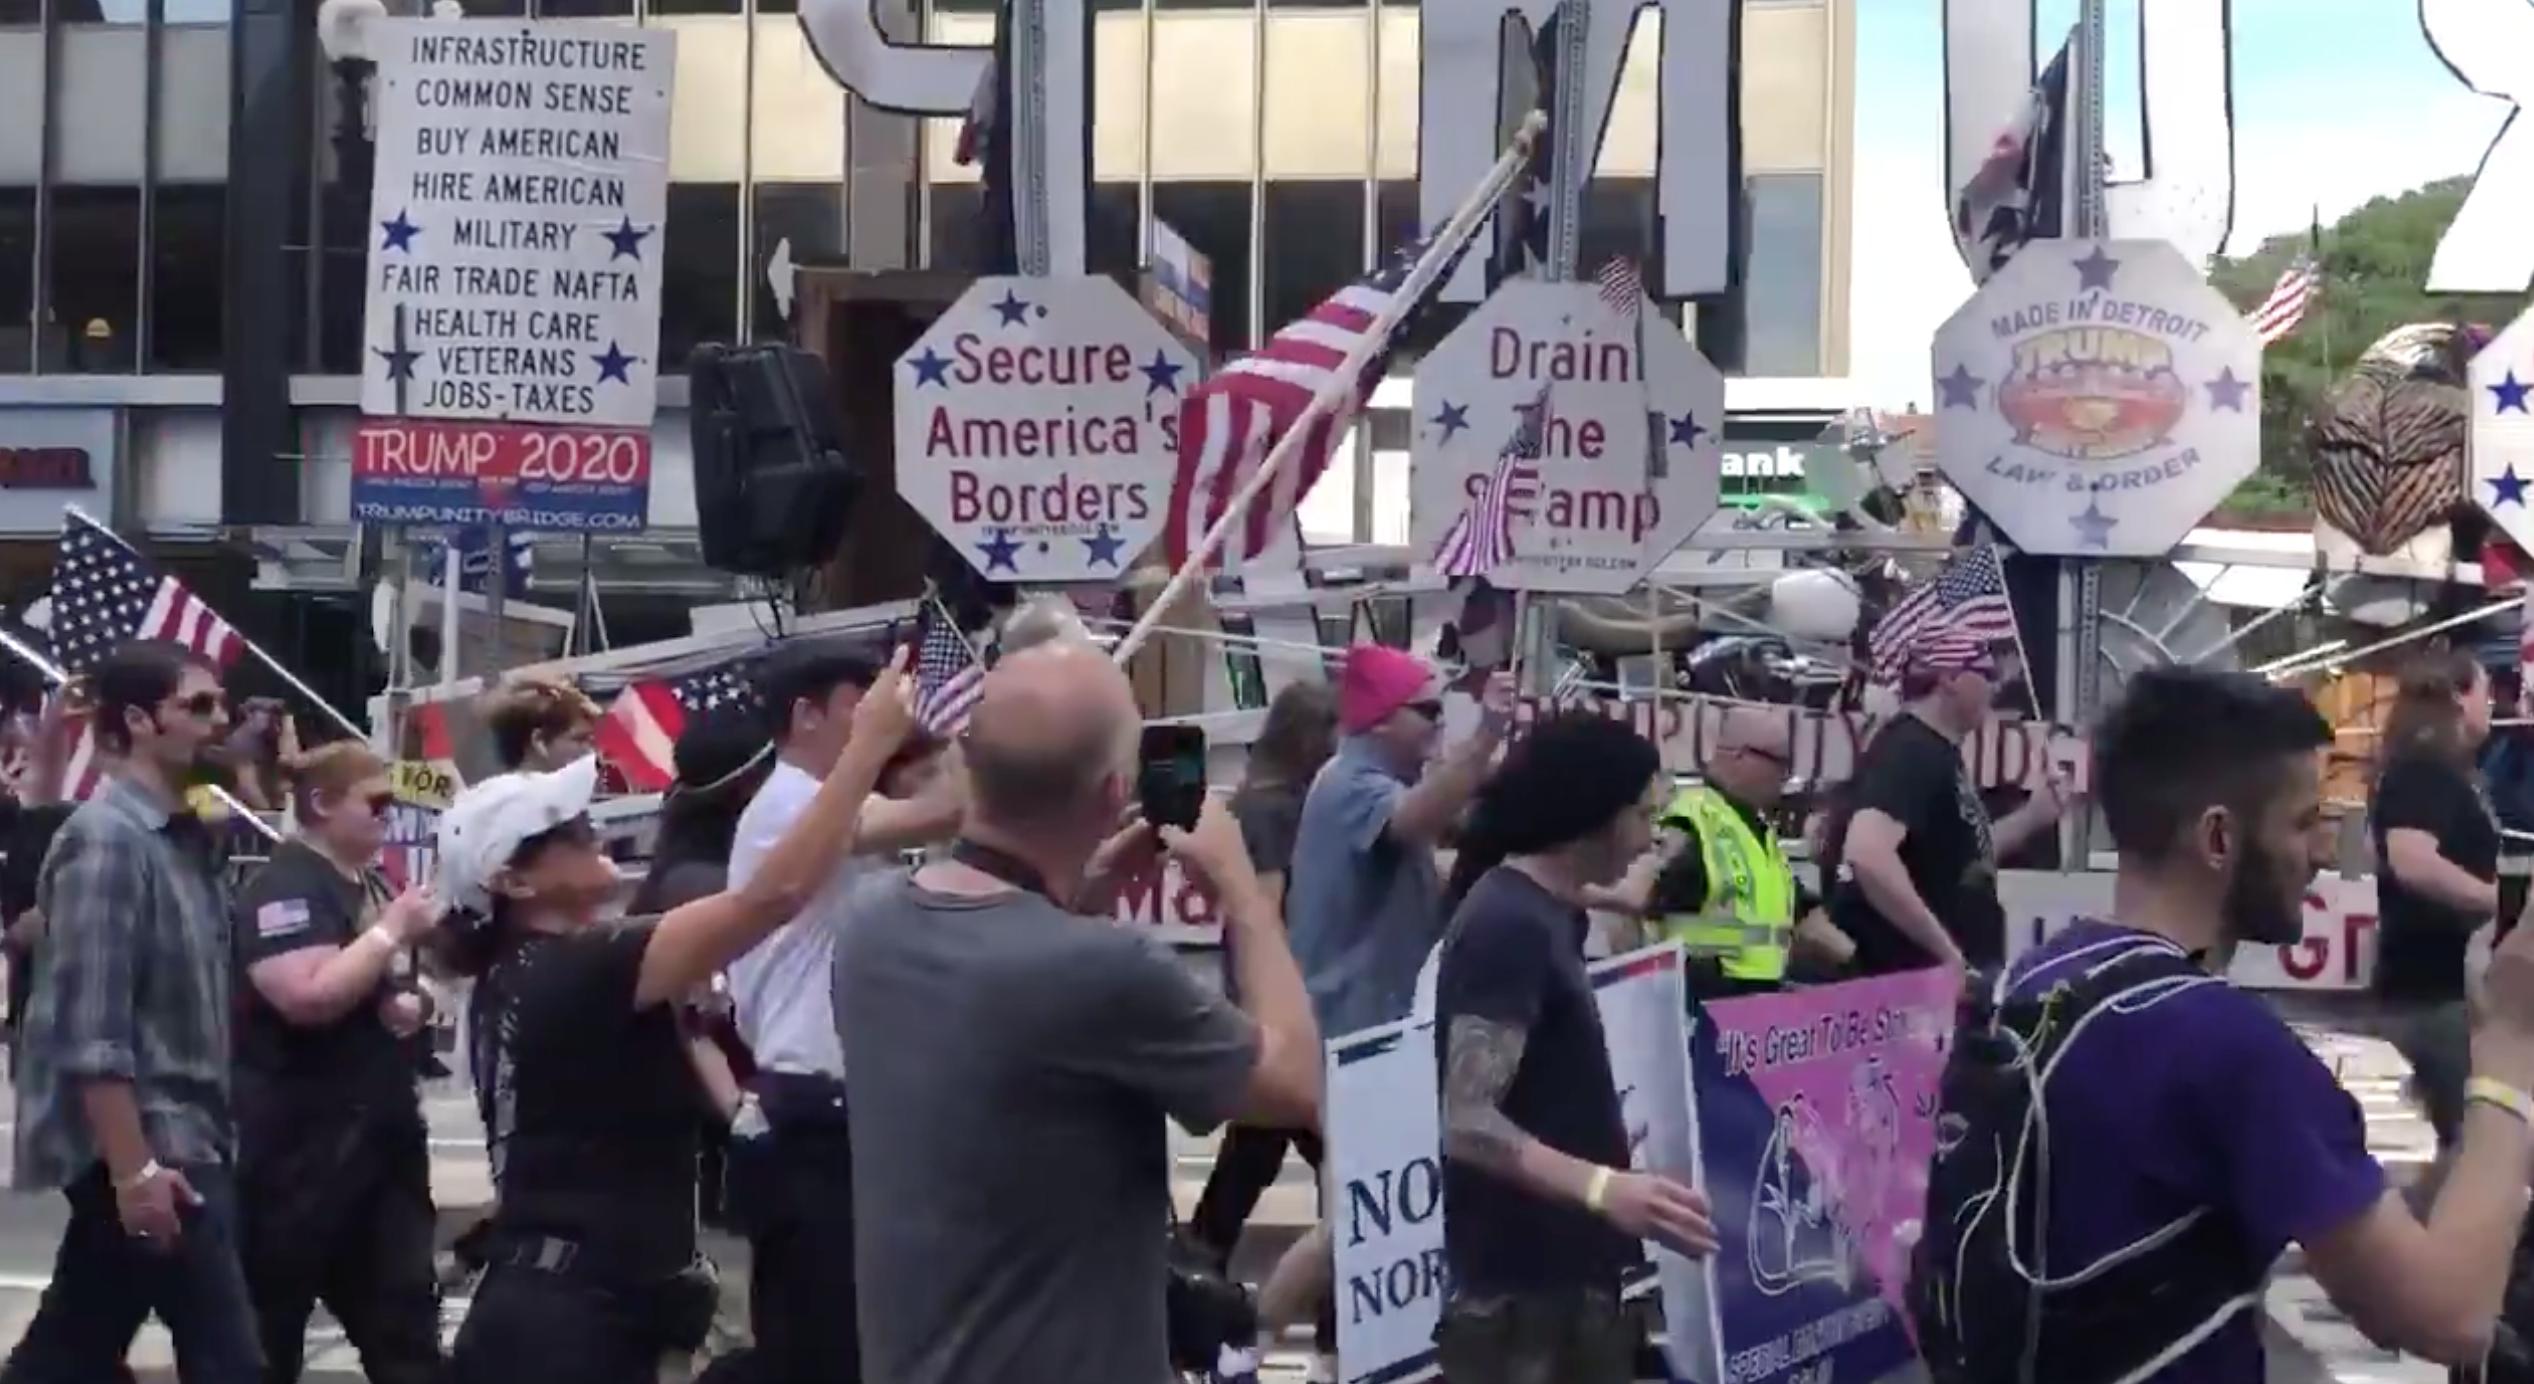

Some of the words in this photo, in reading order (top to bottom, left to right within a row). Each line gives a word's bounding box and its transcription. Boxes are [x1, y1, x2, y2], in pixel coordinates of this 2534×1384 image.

[411, 36, 646, 70] INFRASTRUCTURE
[416, 78, 532, 109] COMMON
[544, 83, 632, 114] SENSE
[417, 128, 470, 156] BUY
[480, 129, 620, 160] AMERICAN
[412, 172, 473, 202] HIRE
[484, 174, 625, 208] AMERICAN
[453, 218, 577, 250] MILITARY
[382, 264, 440, 293] FAIR
[454, 267, 540, 297] TRADE
[554, 270, 639, 301] NAFTA
[415, 308, 517, 338] HEALTH
[528, 311, 600, 342] CARE
[1991, 301, 2060, 339] MADE
[2067, 299, 2094, 321] IN
[2102, 299, 2210, 343] DETROIT
[437, 347, 576, 377] VETERANS
[953, 333, 1131, 385] Secure
[1491, 327, 1629, 382] Drain
[423, 381, 595, 414] JOBS-TAXES
[926, 401, 1179, 459] America's
[359, 429, 497, 475] TRUMP
[519, 432, 640, 483] 2020
[1720, 446, 1806, 476] ank
[1986, 456, 2057, 484] LAW
[2066, 473, 2084, 492] &
[2099, 447, 2202, 492] ORDER
[949, 471, 1149, 523] Borders
